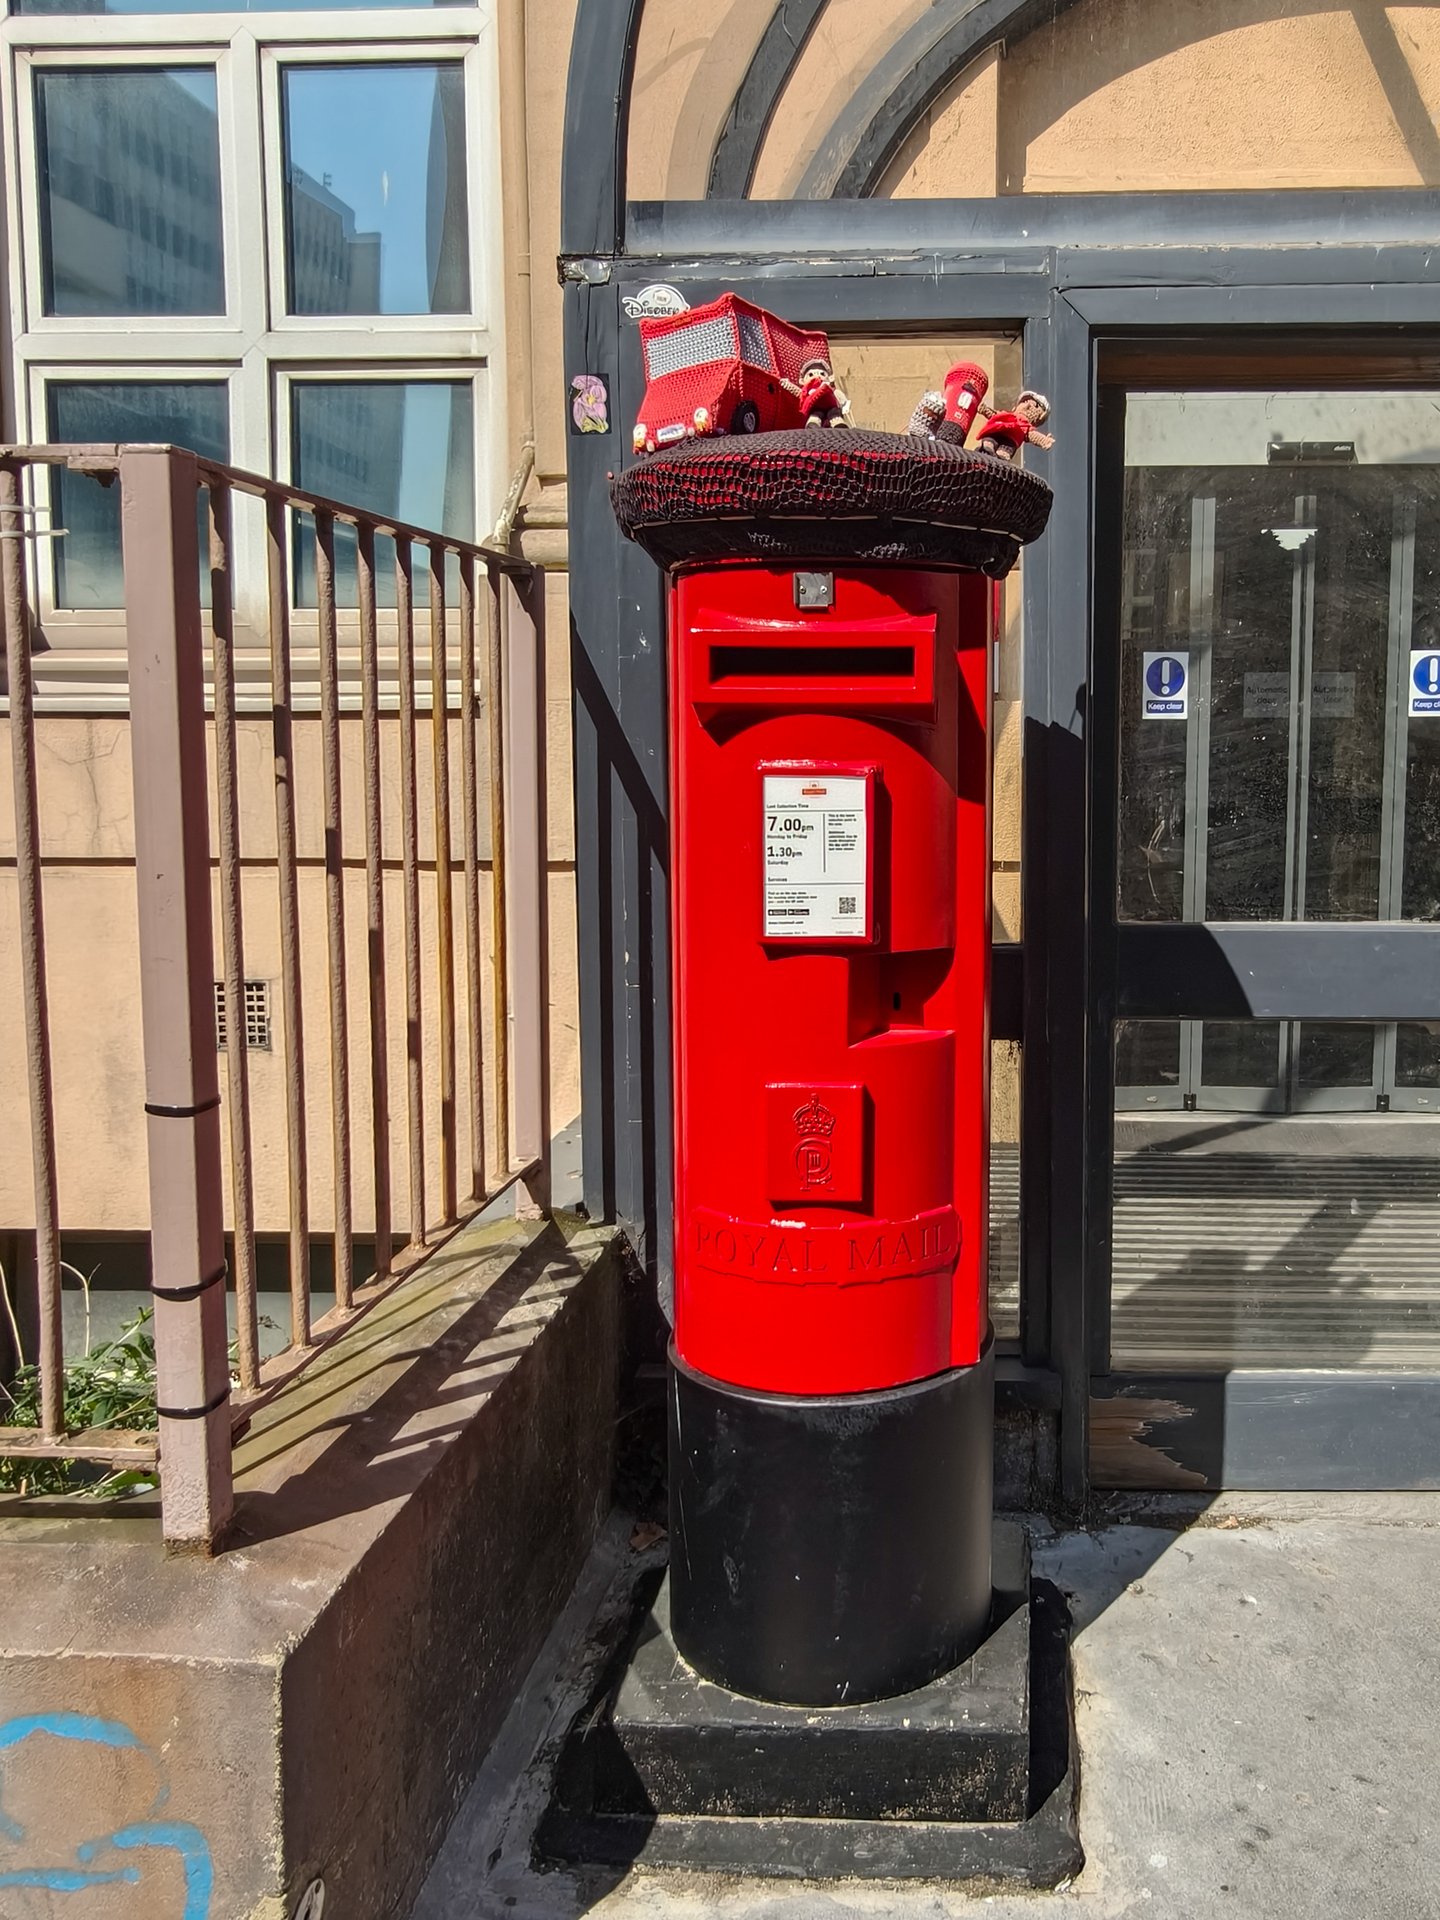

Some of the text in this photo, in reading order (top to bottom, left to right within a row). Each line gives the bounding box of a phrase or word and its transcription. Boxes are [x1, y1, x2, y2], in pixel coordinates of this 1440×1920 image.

[1148, 702, 1166, 711] Keep
[767, 816, 814, 833] 7.00pm
[767, 845, 803, 858] 1.30pm
[695, 1222, 952, 1272] ROYAL MAIL
